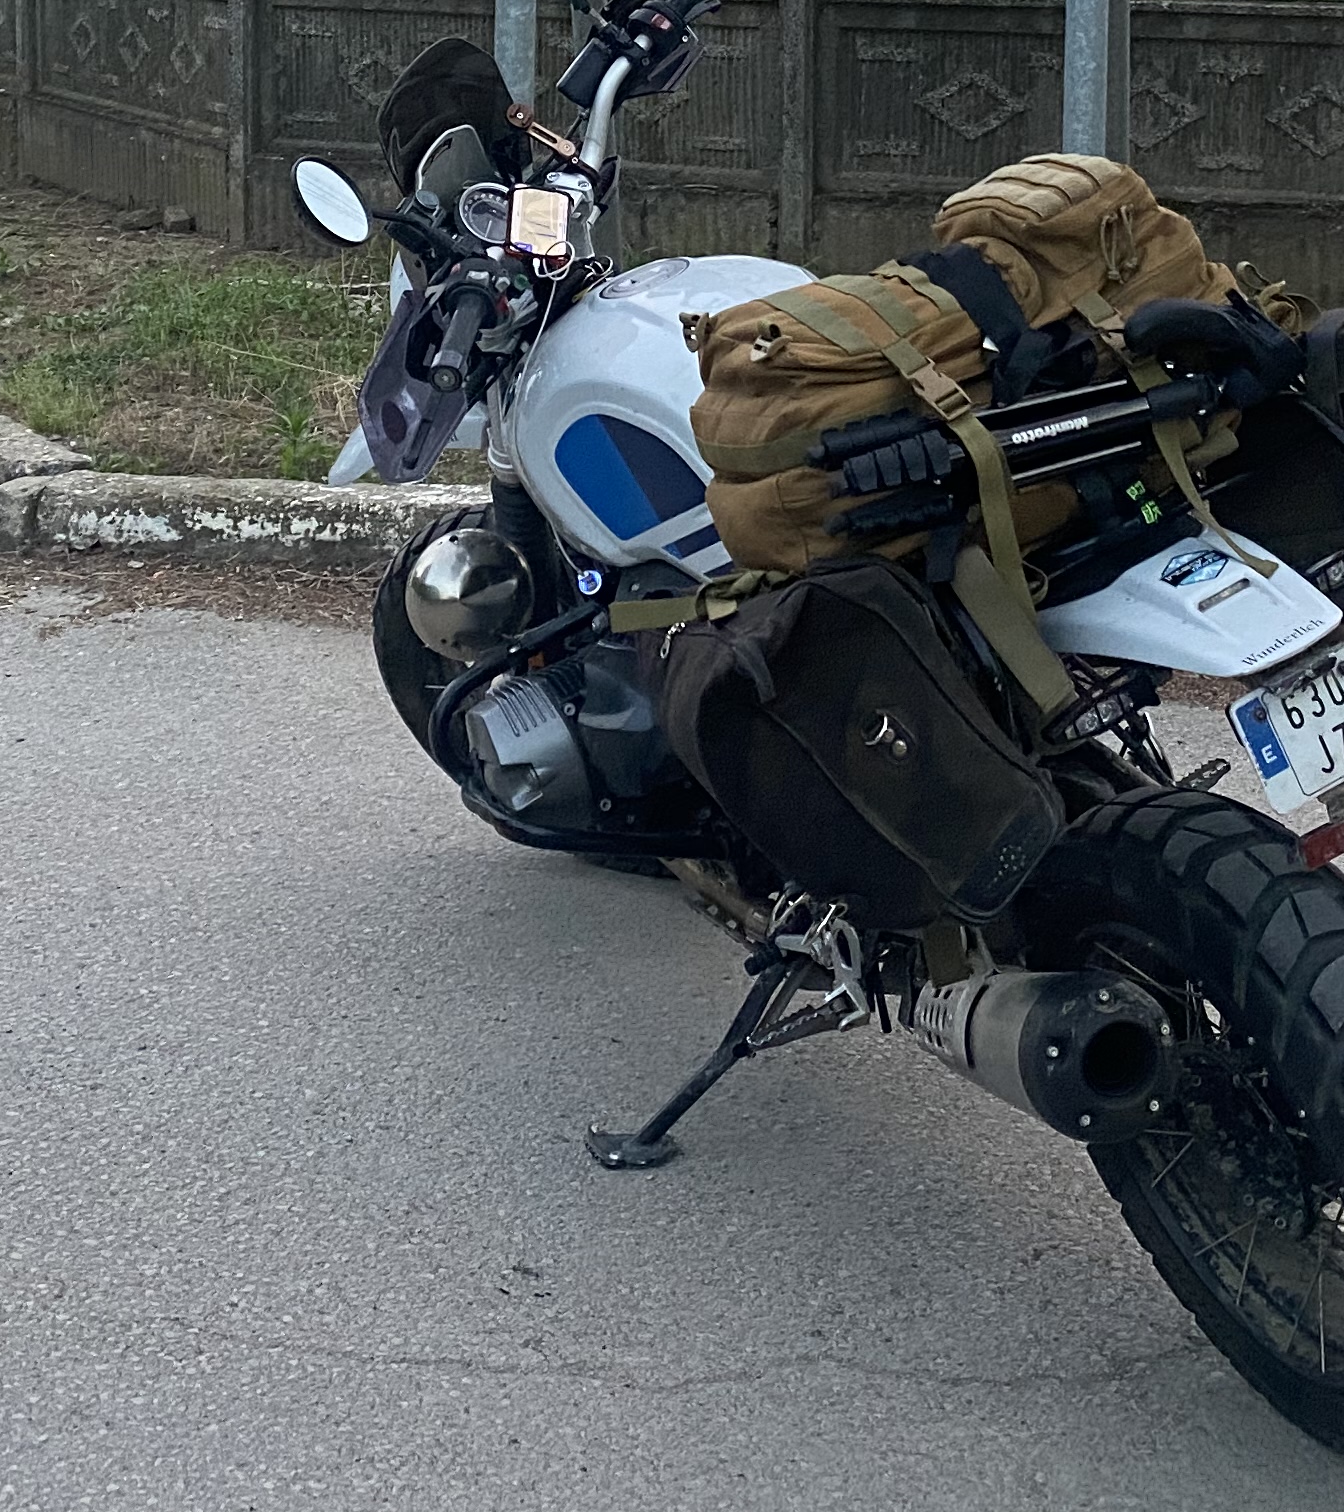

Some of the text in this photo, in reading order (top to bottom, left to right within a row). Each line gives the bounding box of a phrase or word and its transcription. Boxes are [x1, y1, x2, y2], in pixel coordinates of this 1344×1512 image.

[1012, 416, 1089, 444] Manfrotto
[1242, 618, 1325, 667] Wunderlich
[1261, 744, 1277, 764] E
